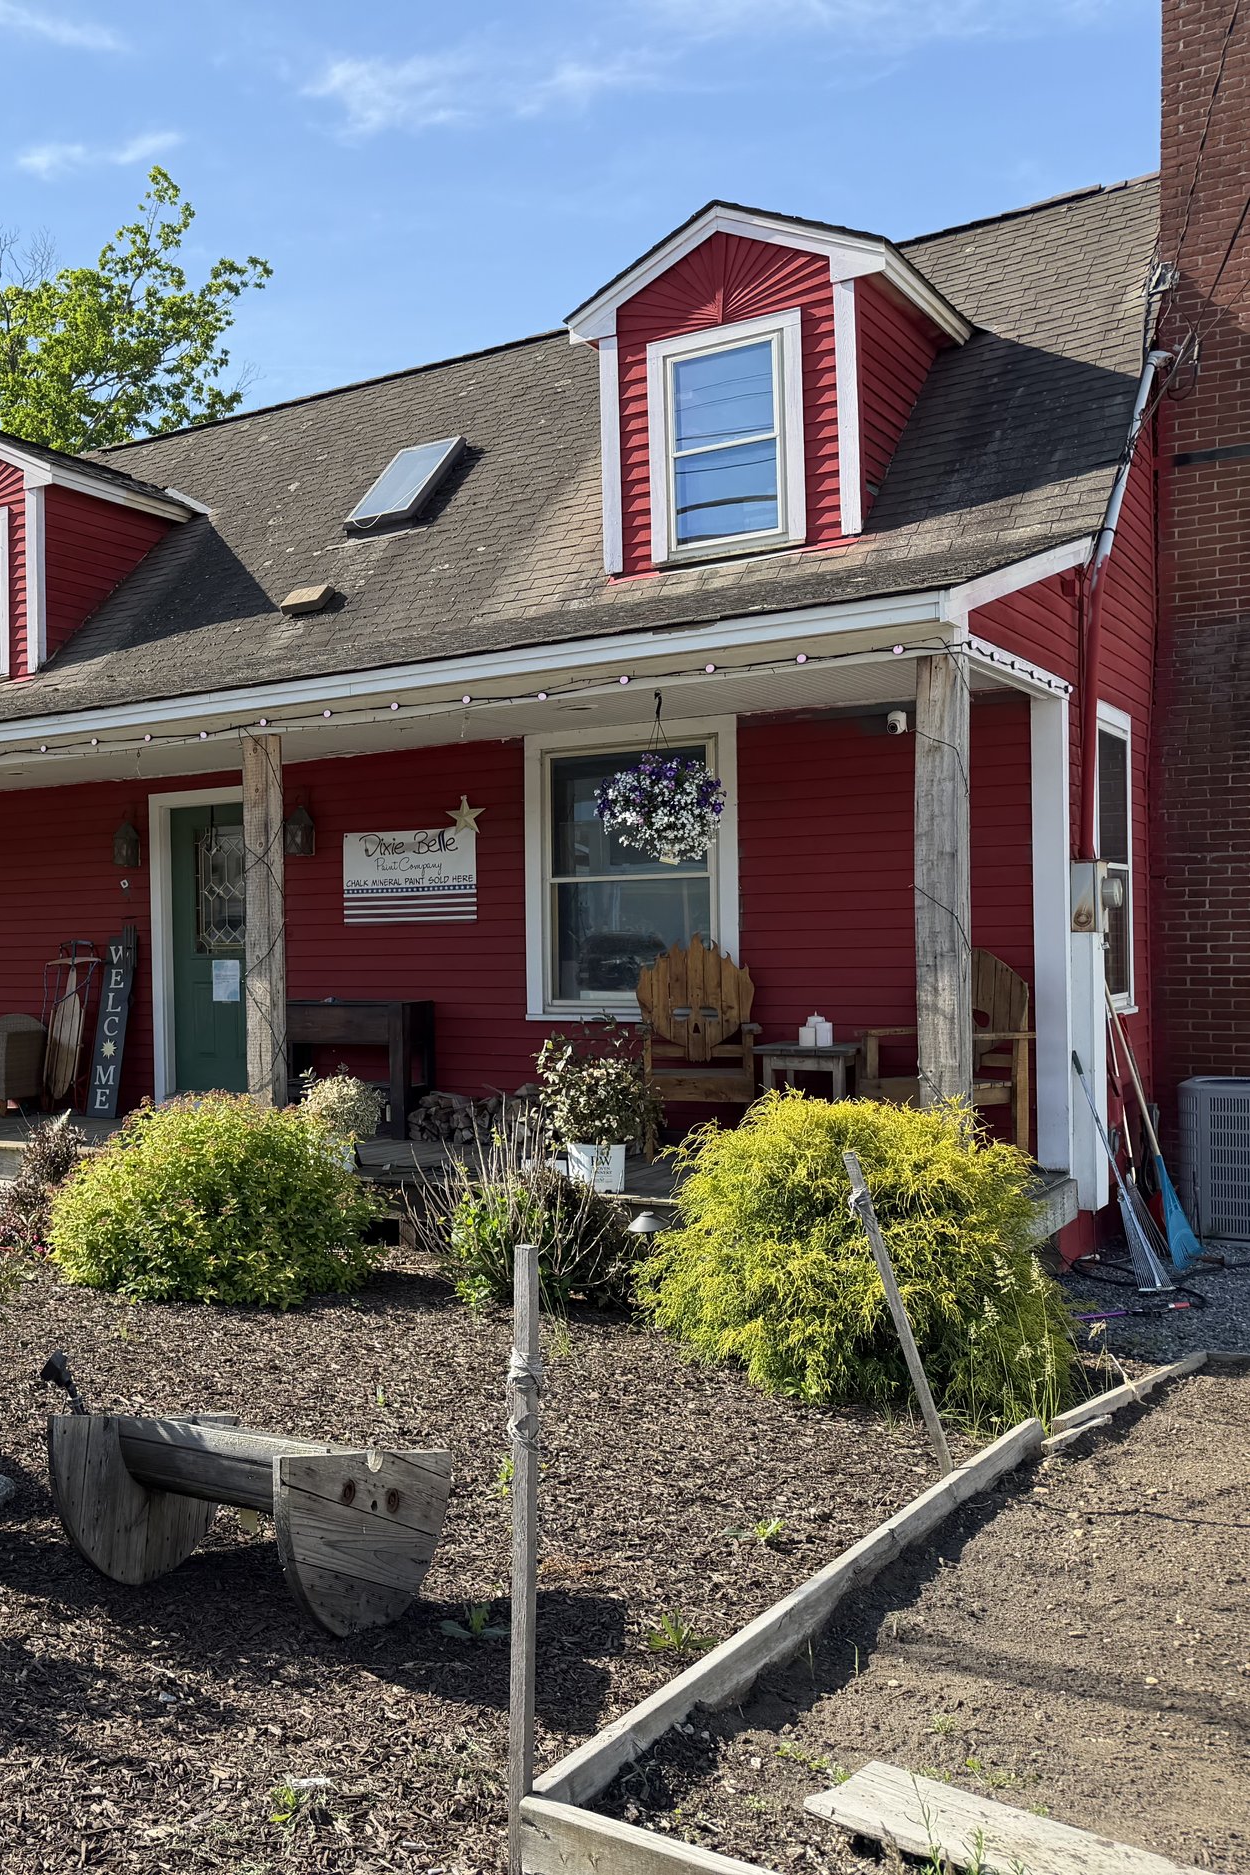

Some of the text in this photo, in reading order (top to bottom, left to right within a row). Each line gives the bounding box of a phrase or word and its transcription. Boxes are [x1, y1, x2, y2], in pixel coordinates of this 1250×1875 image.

[359, 830, 458, 857] Dixie Belle
[374, 857, 442, 877] Paint Company
[346, 874, 474, 888] CHALK MINERAL PAINT SOLD HERE
